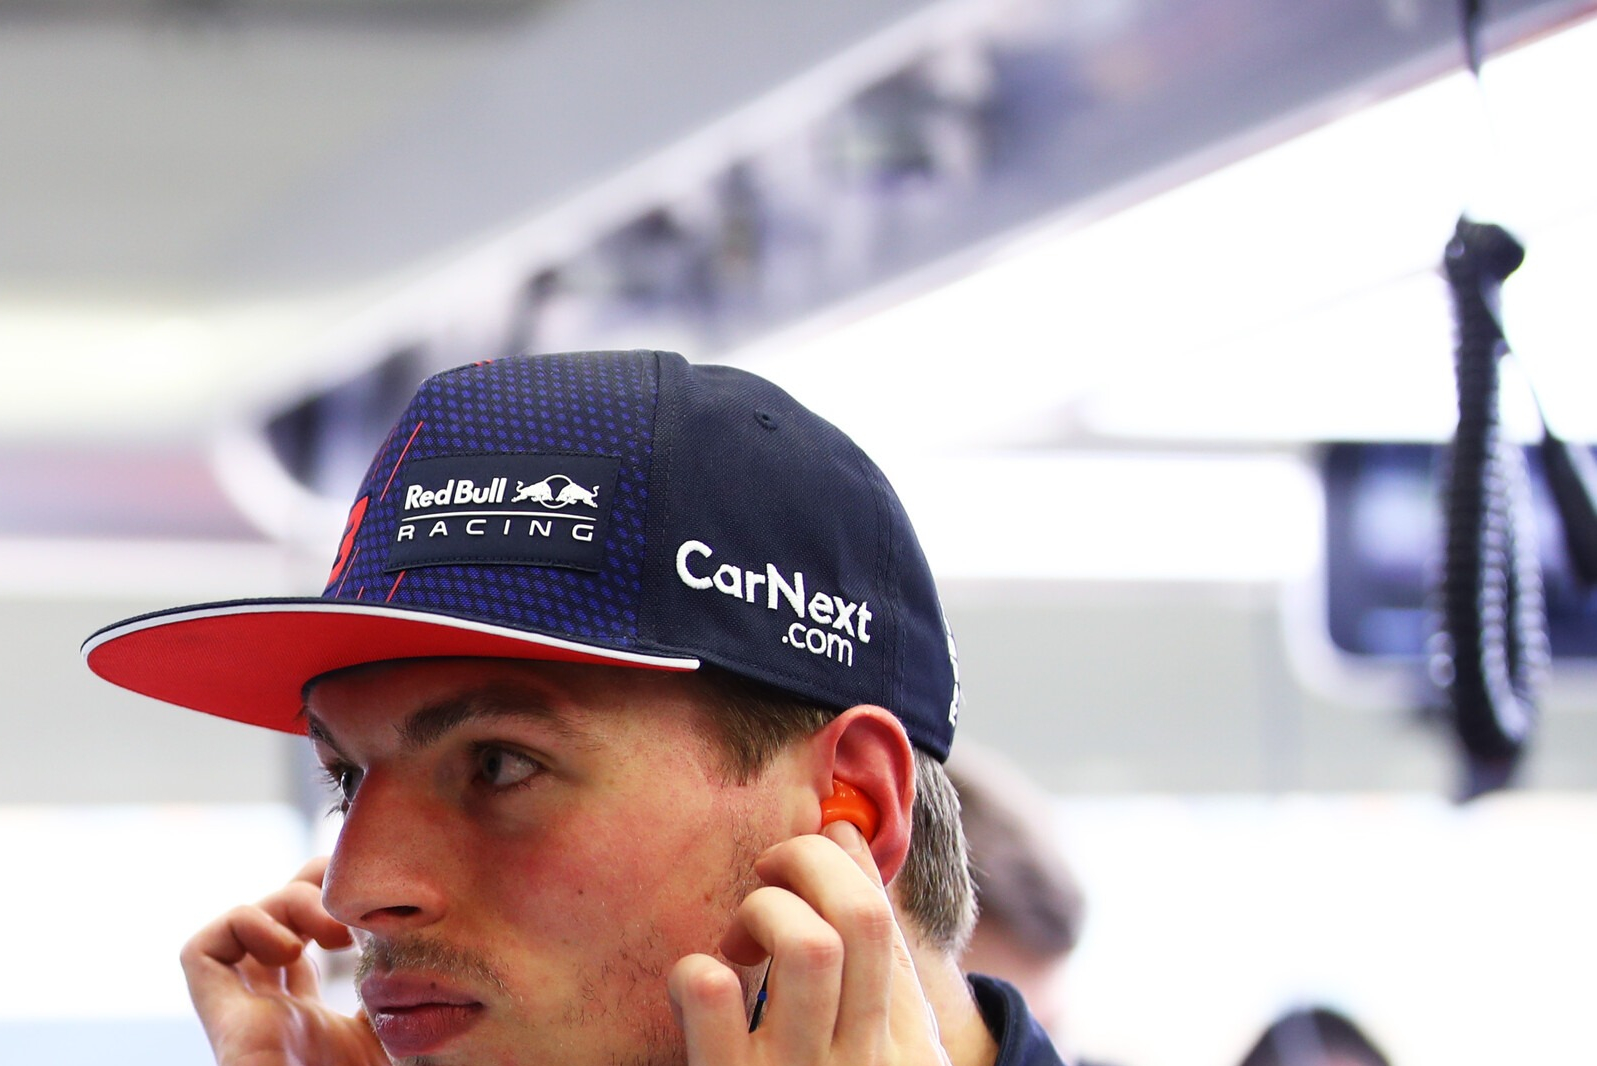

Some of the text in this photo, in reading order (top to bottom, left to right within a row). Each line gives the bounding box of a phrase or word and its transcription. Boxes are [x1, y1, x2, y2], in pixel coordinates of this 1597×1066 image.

[404, 477, 507, 510] Red Bull
[397, 519, 594, 542] RACING
[676, 540, 872, 644] CarNext
[781, 622, 853, 667] .com
